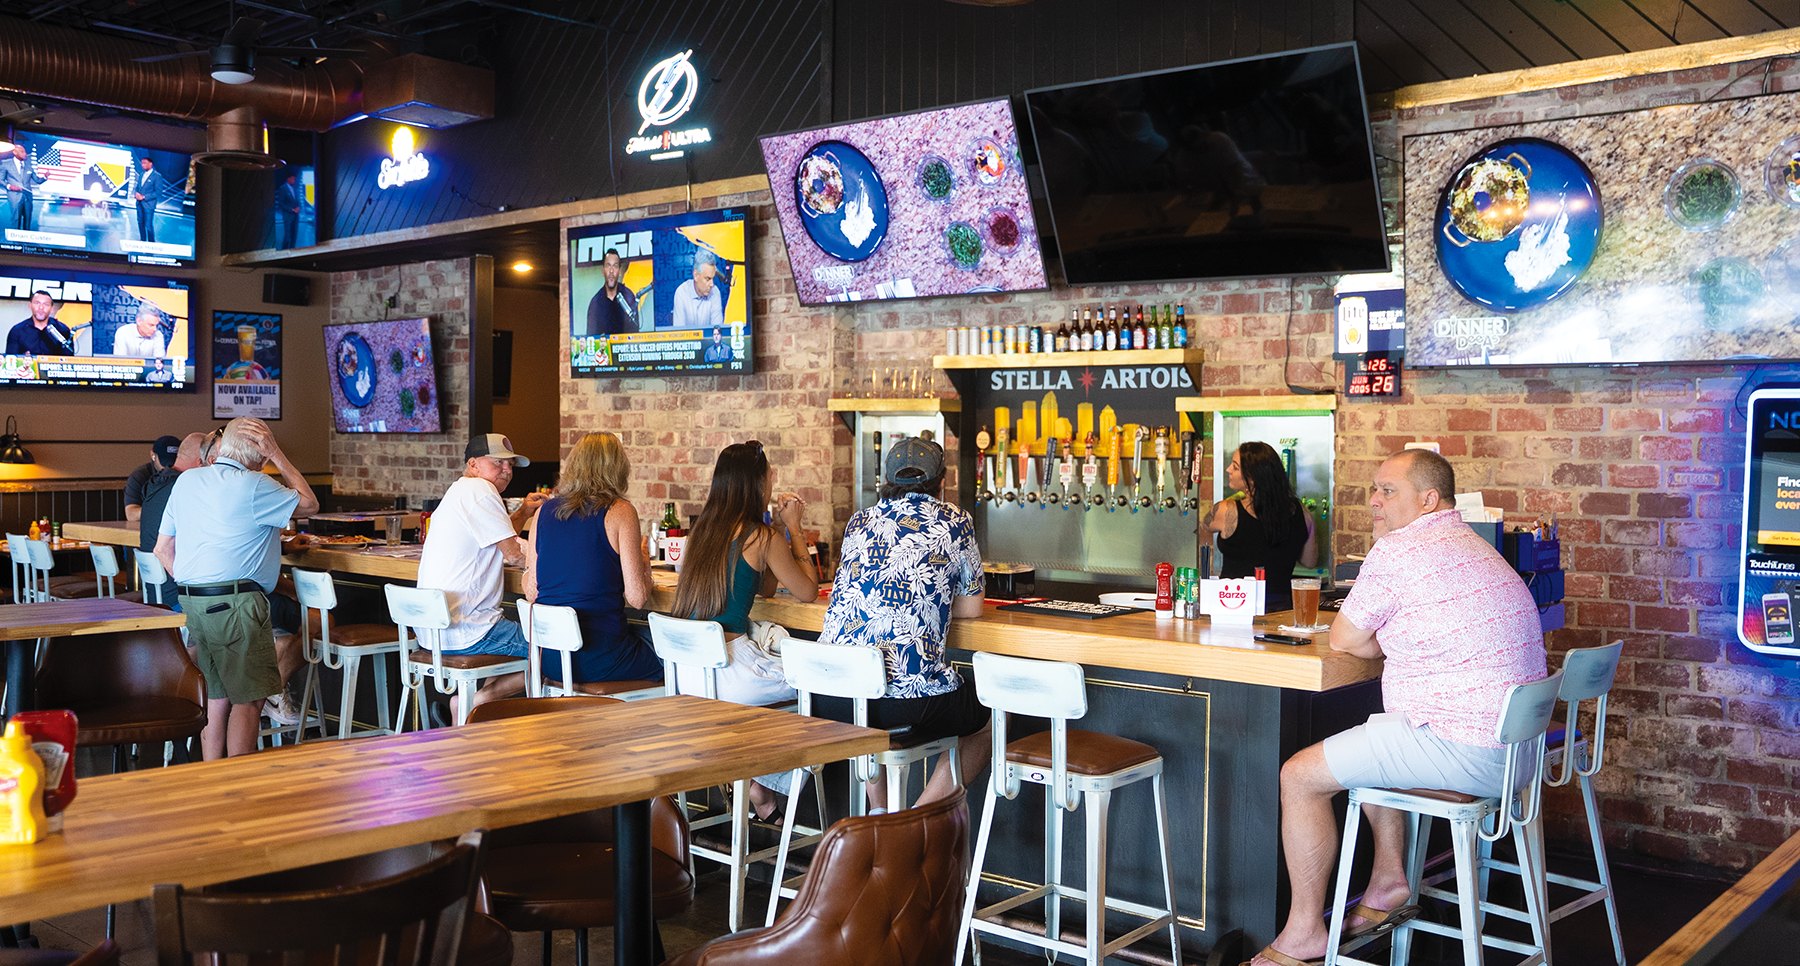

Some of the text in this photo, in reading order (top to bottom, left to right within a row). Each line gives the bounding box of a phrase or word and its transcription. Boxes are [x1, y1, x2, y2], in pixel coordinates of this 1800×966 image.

[671, 127, 711, 146] ULTRA
[639, 343, 655, 352] SOCCER
[655, 342, 673, 351] OFFERS
[990, 367, 1193, 391] STELLA ARTOIS
[1372, 375, 1395, 393] 26
[218, 385, 276, 395] NOW AVAILABLE
[1349, 384, 1371, 394] 2005
[233, 395, 262, 405] ON TAP!
[1749, 559, 1796, 571] TouchTunes
[1218, 591, 1247, 599] Barzo
